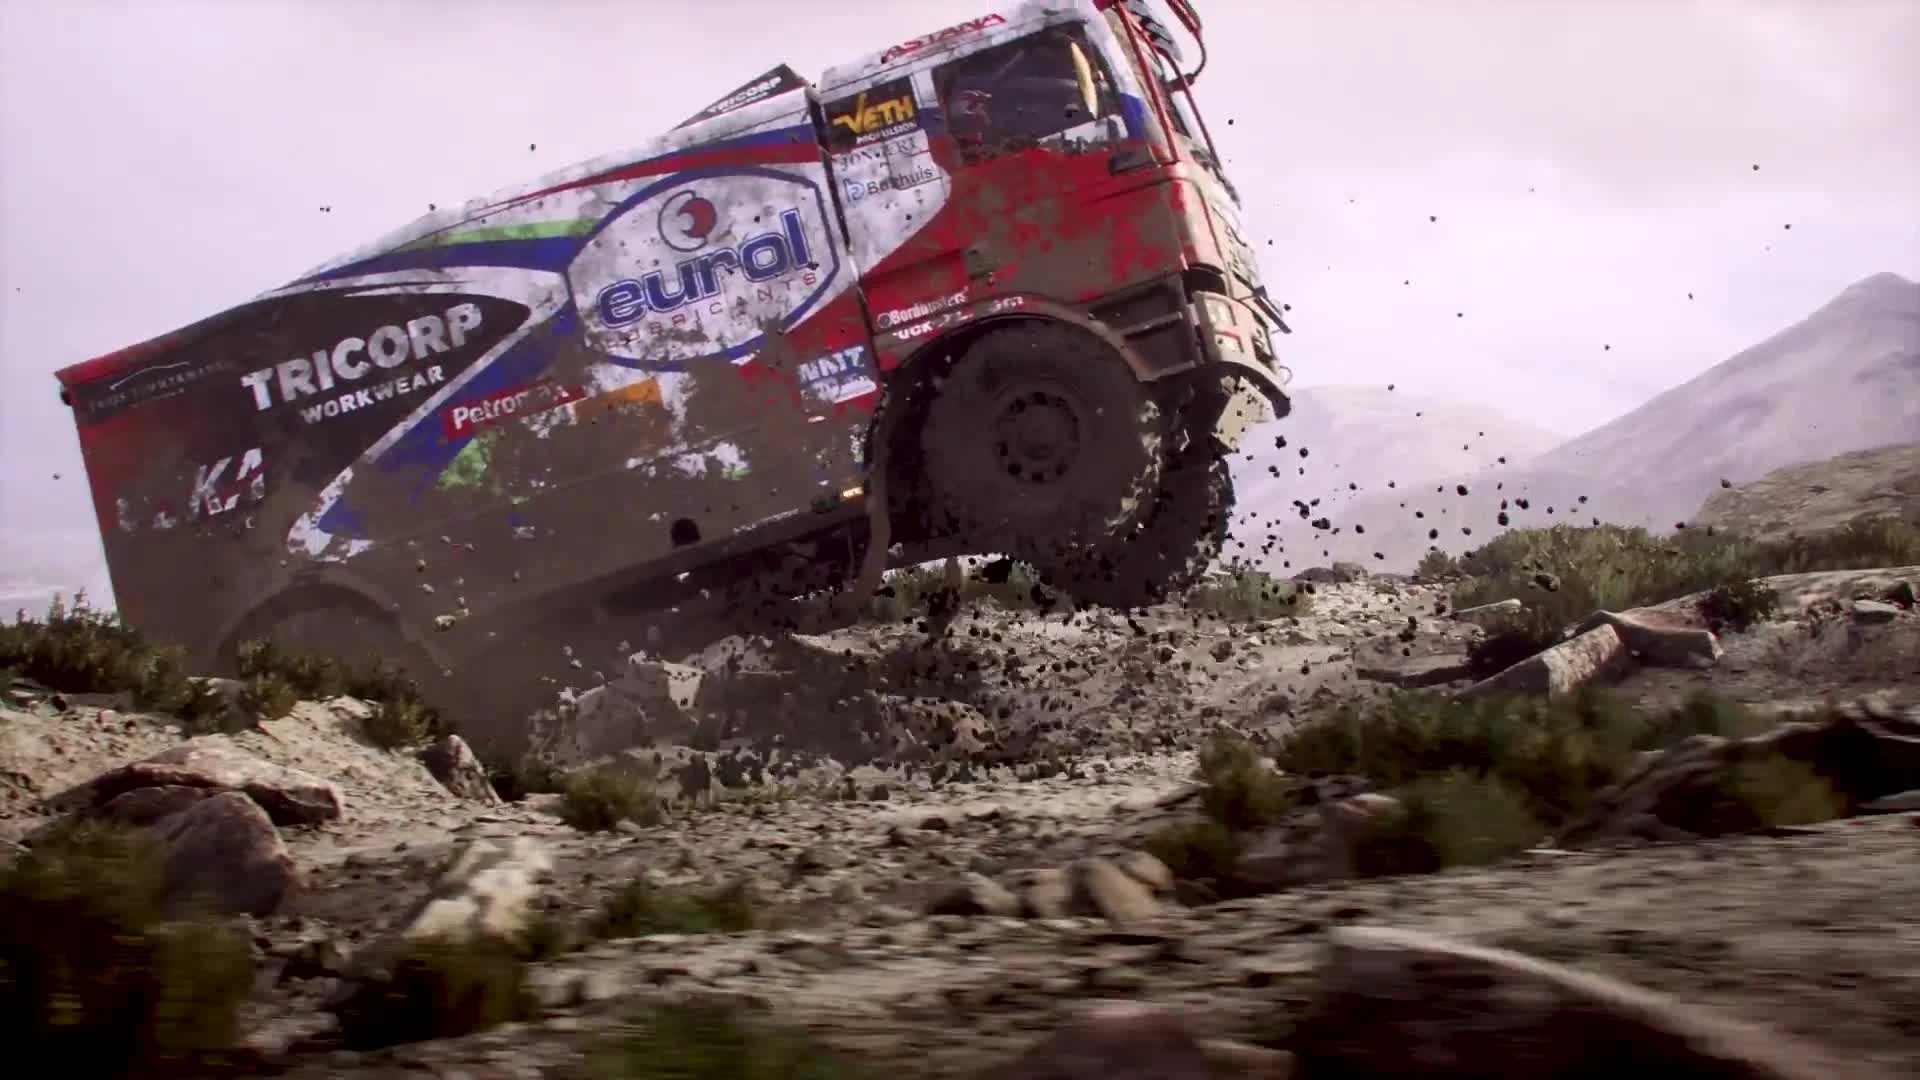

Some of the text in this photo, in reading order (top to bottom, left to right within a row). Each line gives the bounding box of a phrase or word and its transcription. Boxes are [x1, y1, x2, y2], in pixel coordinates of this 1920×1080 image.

[833, 93, 914, 134] VETH
[597, 208, 812, 329] eurol
[240, 303, 483, 411] TRICORP
[301, 365, 445, 424] WORKWEAR
